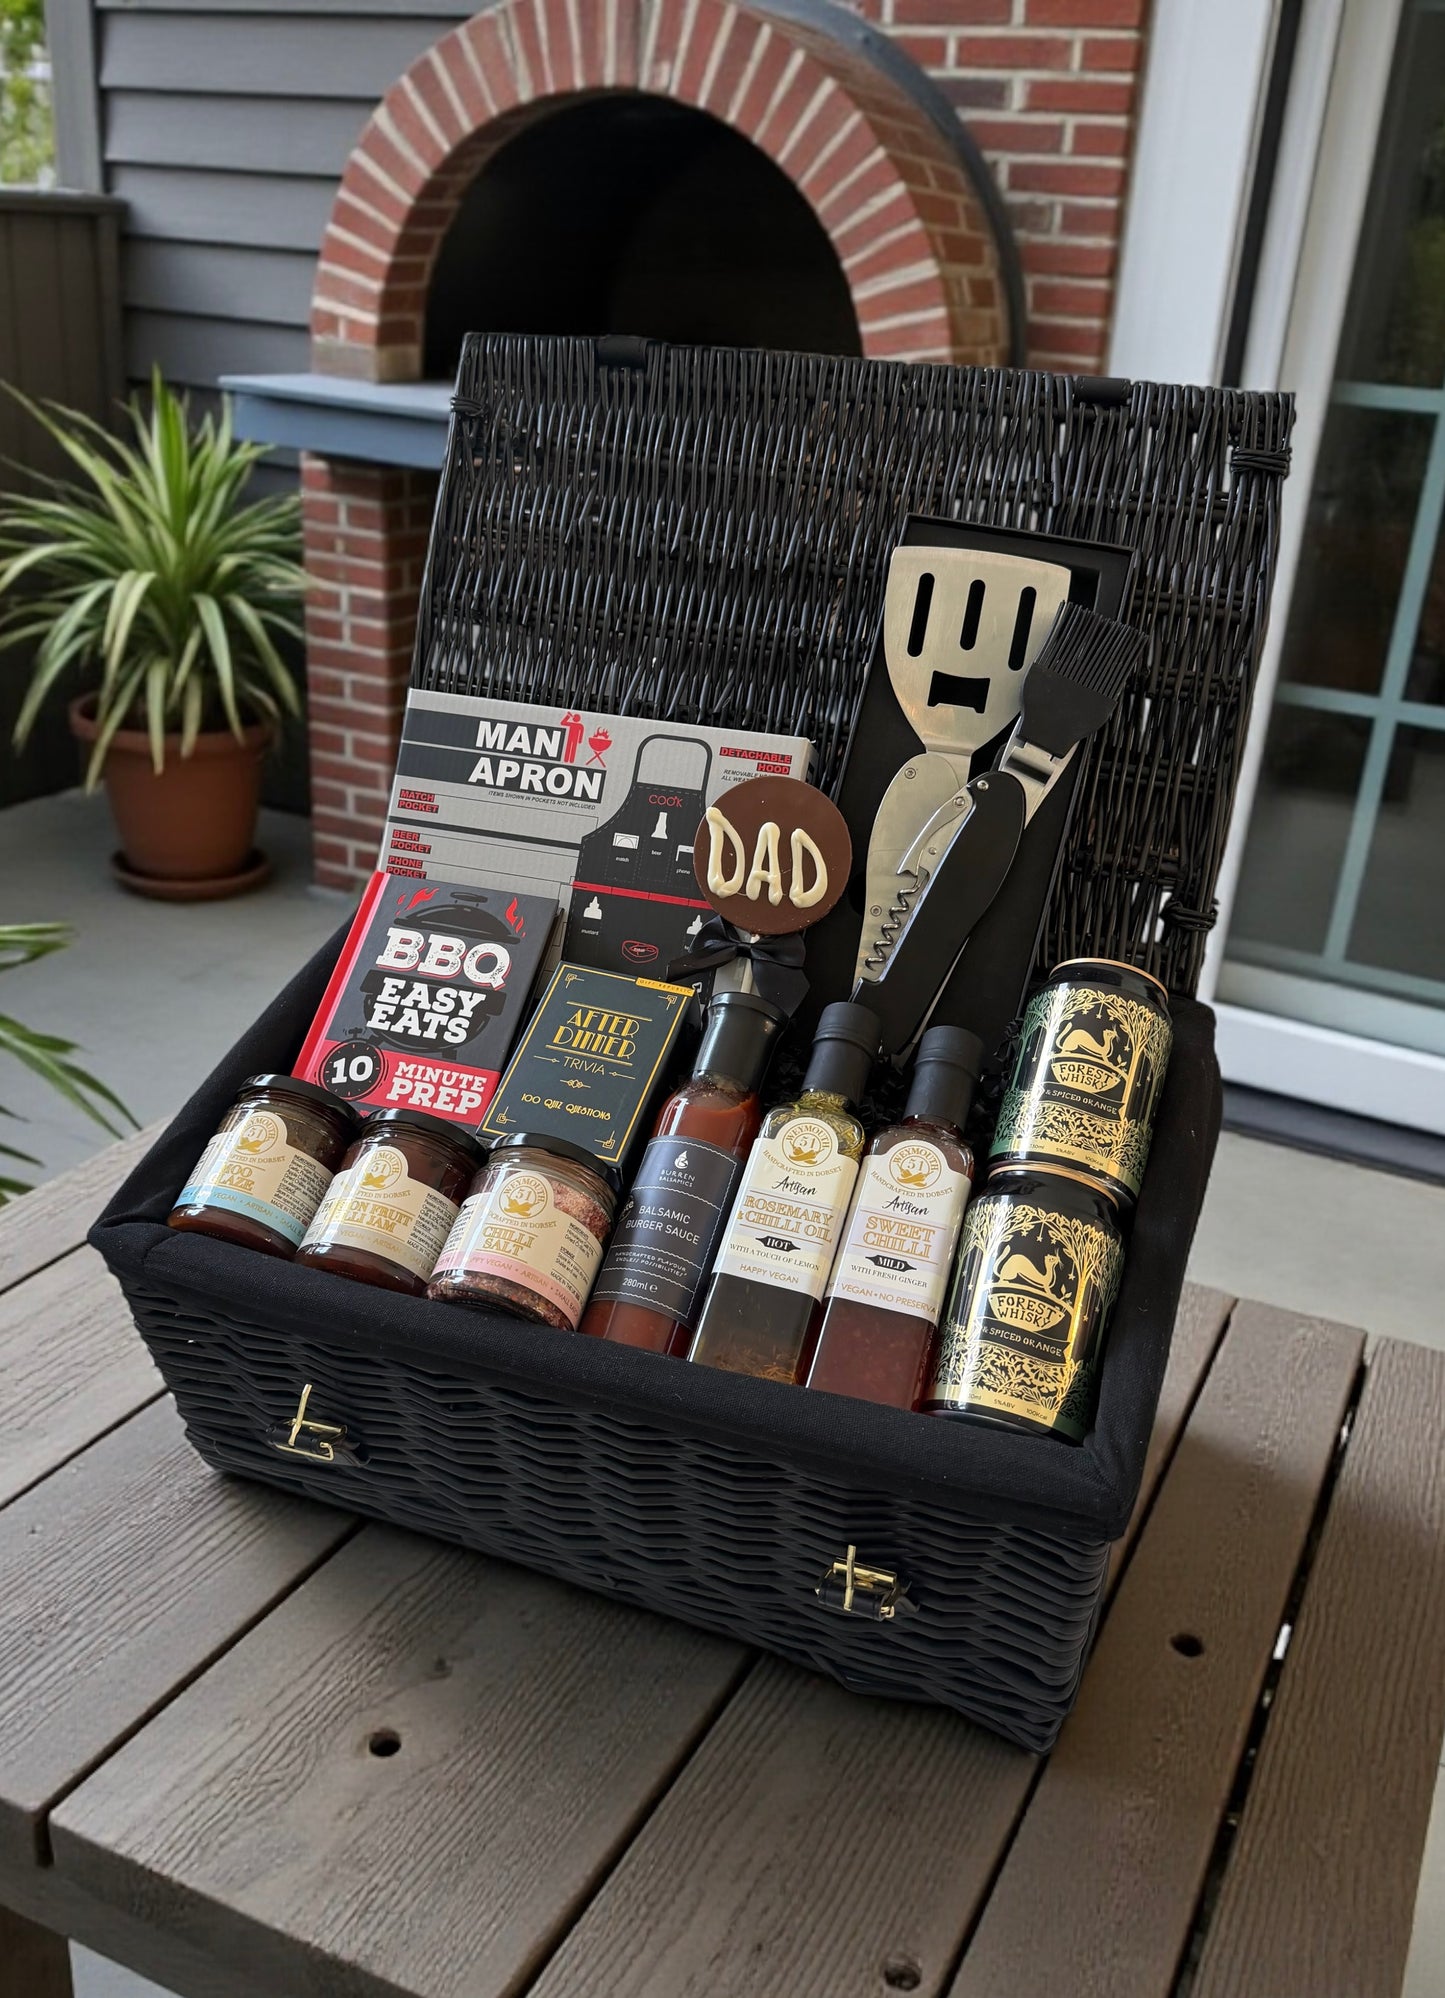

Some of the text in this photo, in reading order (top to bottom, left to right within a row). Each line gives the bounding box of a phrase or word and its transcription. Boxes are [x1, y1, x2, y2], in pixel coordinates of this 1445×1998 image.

[475, 720, 562, 758] MAN
[721, 748, 791, 763] DETACHABLE
[468, 757, 602, 800] APRON
[758, 764, 789, 774] HOOD
[400, 790, 435, 802] MATCH
[504, 792, 525, 801] SHOWN
[532, 796, 556, 805] POCKETS
[568, 800, 595, 810] INCLUDED
[399, 801, 439, 813] POCKET
[393, 830, 420, 841] BEER
[391, 841, 431, 854] POCKET
[705, 807, 828, 908] DAD
[388, 856, 422, 868] PHONE
[386, 866, 426, 879] POCKET
[376, 927, 512, 991] BBQ
[376, 977, 486, 1018] EASY
[367, 1003, 470, 1044] EATS
[567, 1009, 640, 1038] AFTER
[553, 1025, 636, 1059] DINNER
[331, 1055, 373, 1083] 10
[563, 1056, 605, 1075] TRIVIA
[1060, 1063, 1115, 1083] FOREST
[395, 1062, 488, 1092] MINUTE
[1060, 1075, 1108, 1091] WHISKY
[386, 1077, 482, 1114] PREP
[1052, 1089, 1080, 1103] SPICED
[1083, 1096, 1118, 1115] ORANGE
[521, 1093, 611, 1121] 100 QUIZ QUESTIONS
[248, 1129, 262, 1139] 51
[785, 1125, 831, 1148] WEYMOUTH
[799, 1136, 816, 1149] 51
[372, 1163, 386, 1173] 51
[763, 1150, 806, 1177] HANDCRAFTED
[815, 1167, 842, 1177] DORSET
[893, 1147, 939, 1171] WEYMOUTH
[907, 1158, 924, 1171] 51
[212, 1173, 255, 1191] LAZE
[659, 1176, 693, 1187] BALSAMICS
[660, 1169, 696, 1182] BURREN
[772, 1176, 818, 1195] Artisan
[870, 1170, 916, 1197] HANDCRAFTED
[925, 1187, 953, 1198] DORSET
[504, 1176, 547, 1203] WEYMOUTH
[515, 1189, 532, 1200] 51
[371, 1204, 413, 1227] FRUIT
[639, 1205, 691, 1224] BALSAMIC
[744, 1195, 834, 1227] ROSEMARY
[882, 1196, 929, 1215] Artisan
[367, 1217, 397, 1233] JAM
[529, 1221, 557, 1229] DORSET
[625, 1220, 700, 1246] BURGER SAUCE
[745, 1211, 800, 1233] CHILLI
[804, 1226, 832, 1243] OIL
[866, 1216, 935, 1243] SWEET
[482, 1226, 535, 1249] CHILLI
[766, 1238, 791, 1251] HOT
[863, 1231, 931, 1258] CHILLI
[482, 1239, 524, 1257] SALT
[730, 1243, 750, 1254] WITH
[755, 1250, 781, 1262] TOUCH
[782, 1256, 793, 1264] OF
[794, 1259, 820, 1271] LEMON
[485, 1257, 512, 1271] VEGAN
[615, 1252, 686, 1271] HANDCRAFTED FLAVOUR
[877, 1256, 905, 1270] MILD
[622, 1277, 648, 1291] 280ml
[740, 1264, 799, 1284] HAPPY VEGAN
[851, 1264, 928, 1289] WITH FRESH GINGER
[841, 1283, 873, 1297] VEGAN
[879, 1292, 894, 1303] NO
[998, 1295, 1060, 1318] FOREST
[998, 1308, 1051, 1329] WHISKY
[989, 1328, 1021, 1343] SPICED
[1022, 1336, 1062, 1357] ORANGE
